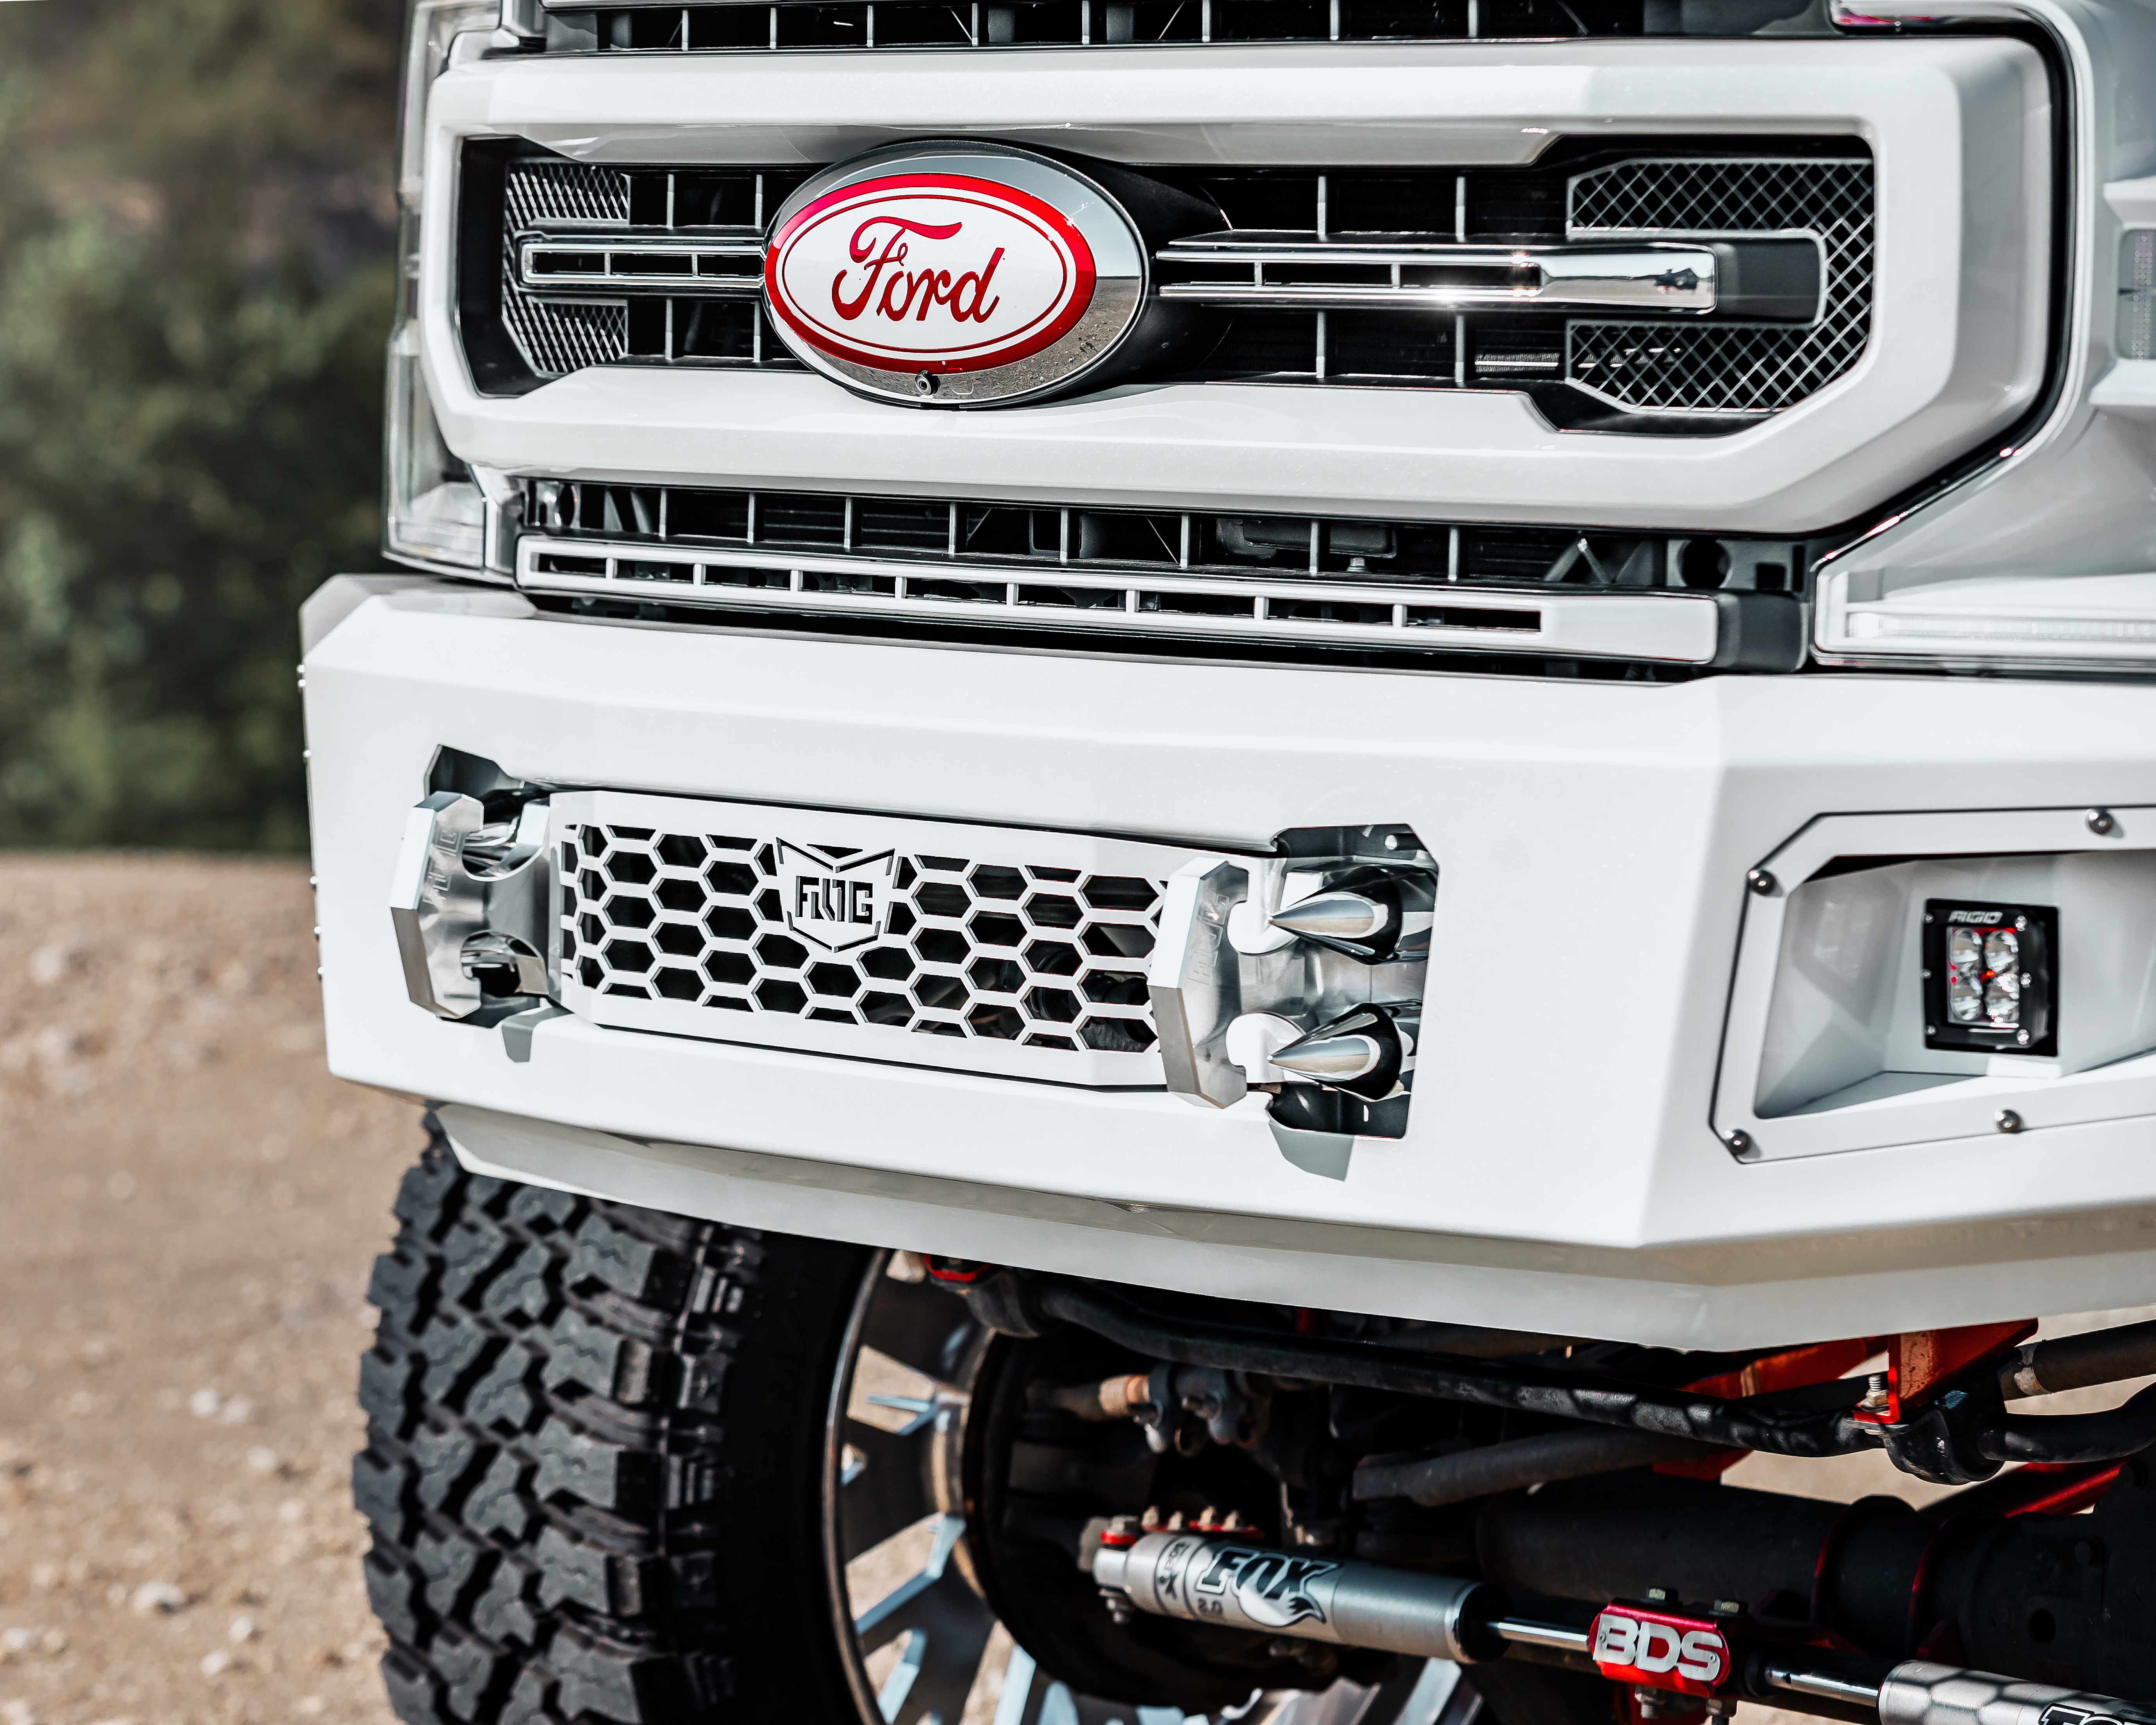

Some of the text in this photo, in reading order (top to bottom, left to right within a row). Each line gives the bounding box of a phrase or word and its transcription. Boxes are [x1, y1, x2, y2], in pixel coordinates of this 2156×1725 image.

[832, 216, 1005, 323] Ford
[1196, 1546, 1339, 1599] FOX
[1593, 1614, 1723, 1681] BDS
